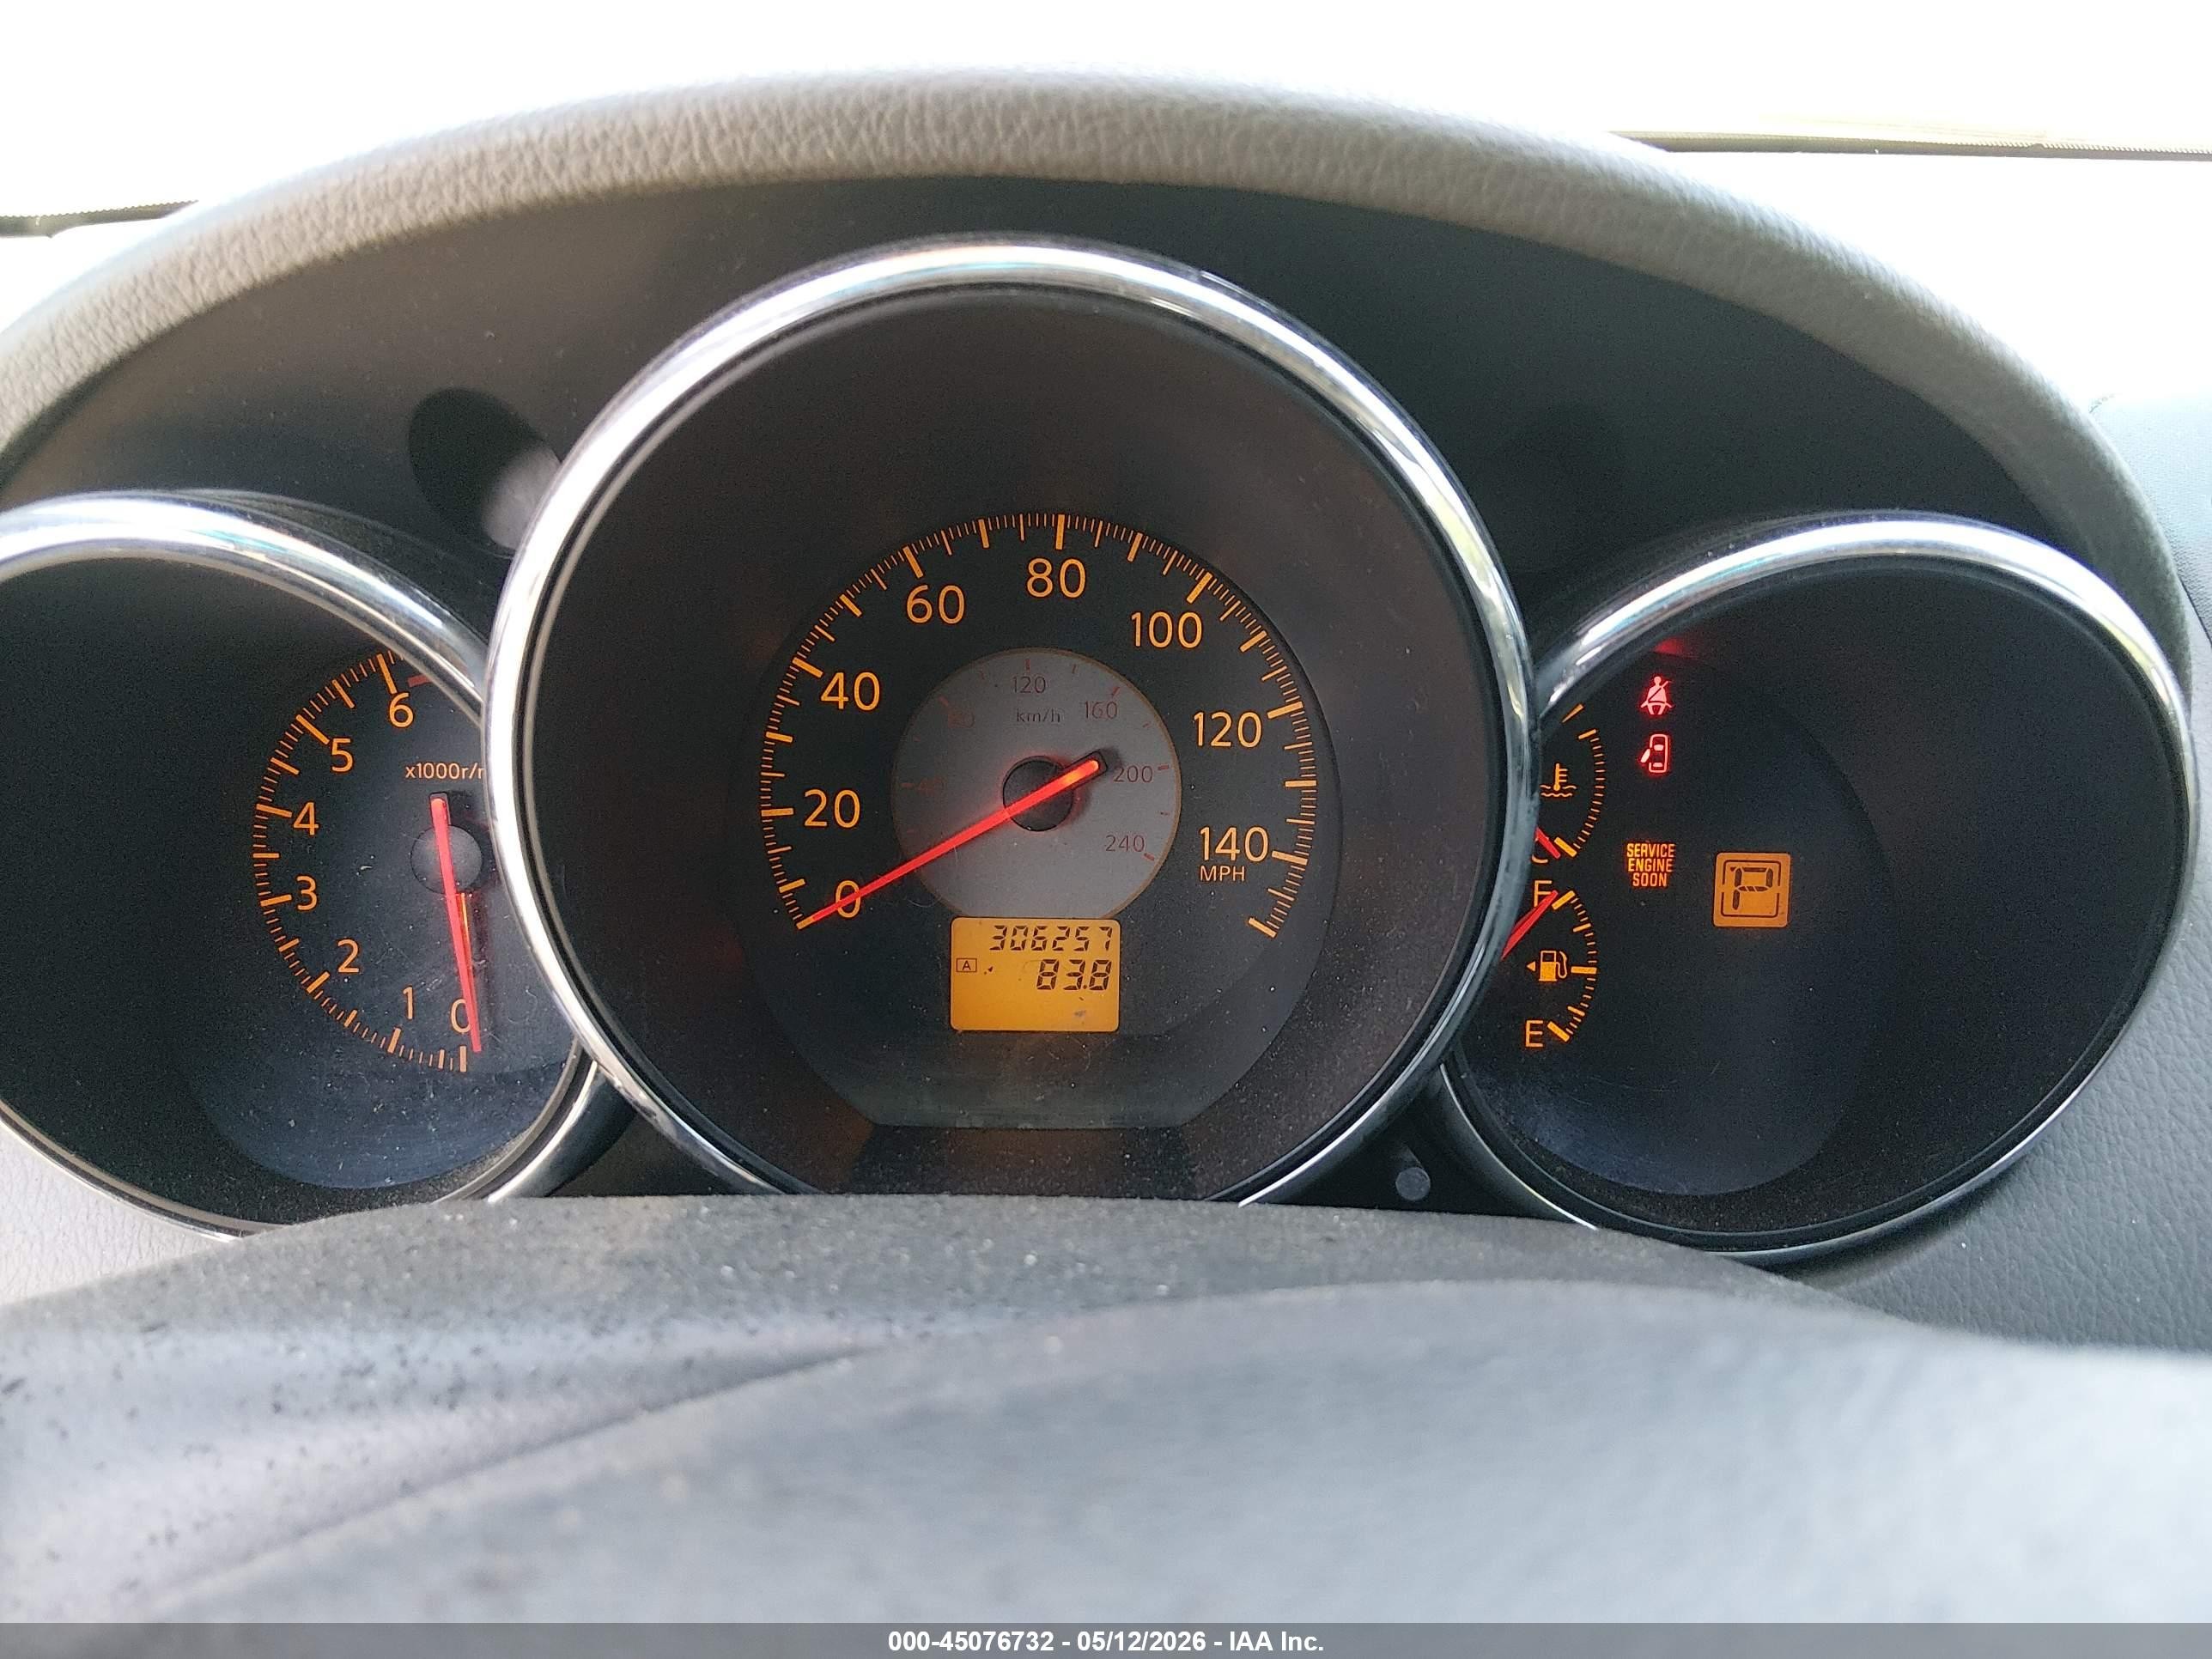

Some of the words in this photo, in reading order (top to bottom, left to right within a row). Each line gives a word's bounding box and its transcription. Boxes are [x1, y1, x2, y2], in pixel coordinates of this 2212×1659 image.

[1027, 557, 1087, 599] 80
[906, 584, 966, 625] 60
[1131, 611, 1203, 649] 100
[820, 671, 881, 712] 40
[1012, 675, 1048, 695] 120
[389, 691, 415, 728] 6
[1016, 707, 1061, 723] km/h
[1084, 700, 1120, 720] 160
[1193, 710, 1262, 749] 120
[331, 738, 355, 774] 5
[1113, 764, 1154, 784] 200
[293, 801, 319, 836] 4
[804, 788, 860, 830] 20
[1104, 834, 1146, 853] 240
[1200, 825, 1269, 862] 140
[1626, 842, 1676, 858] SERVICE
[1200, 865, 1245, 882] MPH
[1628, 858, 1674, 872] ENGINE
[1632, 872, 1668, 887] SOON
[296, 875, 319, 911] 3
[835, 879, 861, 919] 0
[1730, 866, 1774, 911] P
[989, 925, 1113, 951] 306257
[337, 939, 360, 974] 2
[1036, 958, 1113, 991] 83.8
[403, 986, 414, 1020] 1
[450, 998, 473, 1035] 0
[1525, 1019, 1544, 1048] E
